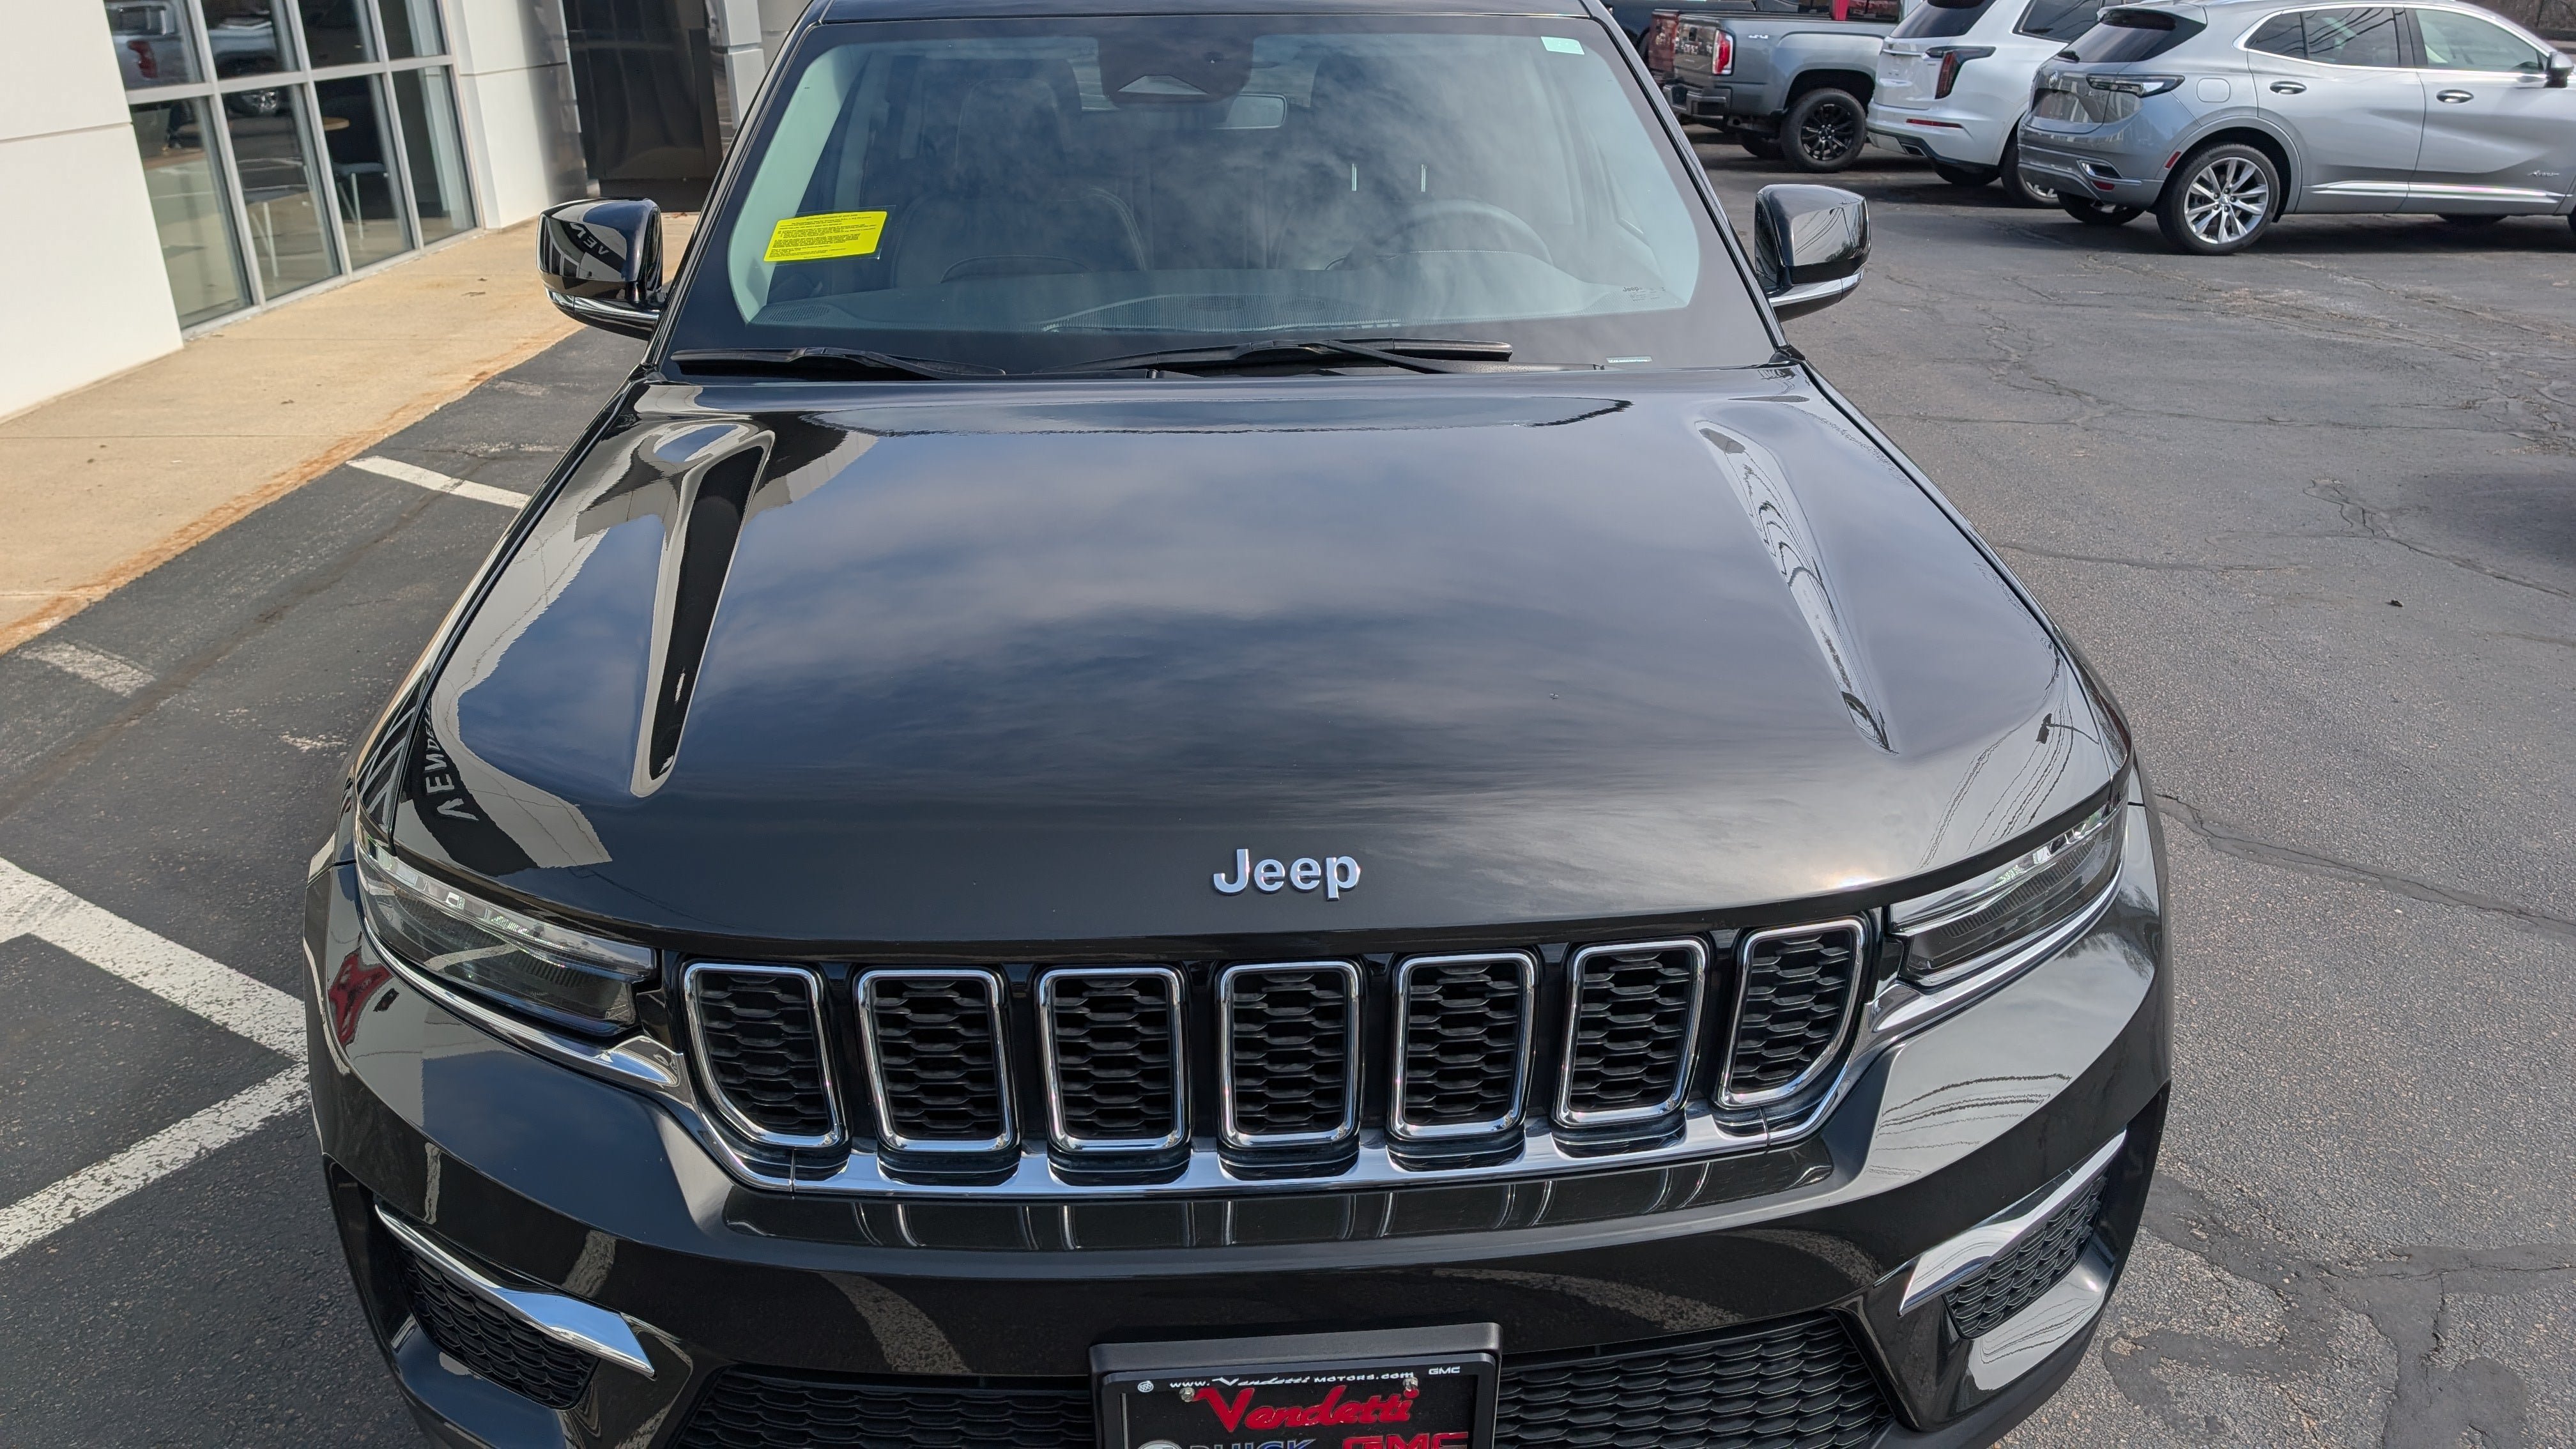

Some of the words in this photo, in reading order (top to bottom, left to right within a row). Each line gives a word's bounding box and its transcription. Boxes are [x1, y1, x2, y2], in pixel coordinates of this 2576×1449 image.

[1213, 848, 1361, 901] Jeep
[1428, 1365, 1460, 1375] GMC
[1192, 1384, 1420, 1433] Vendetti
